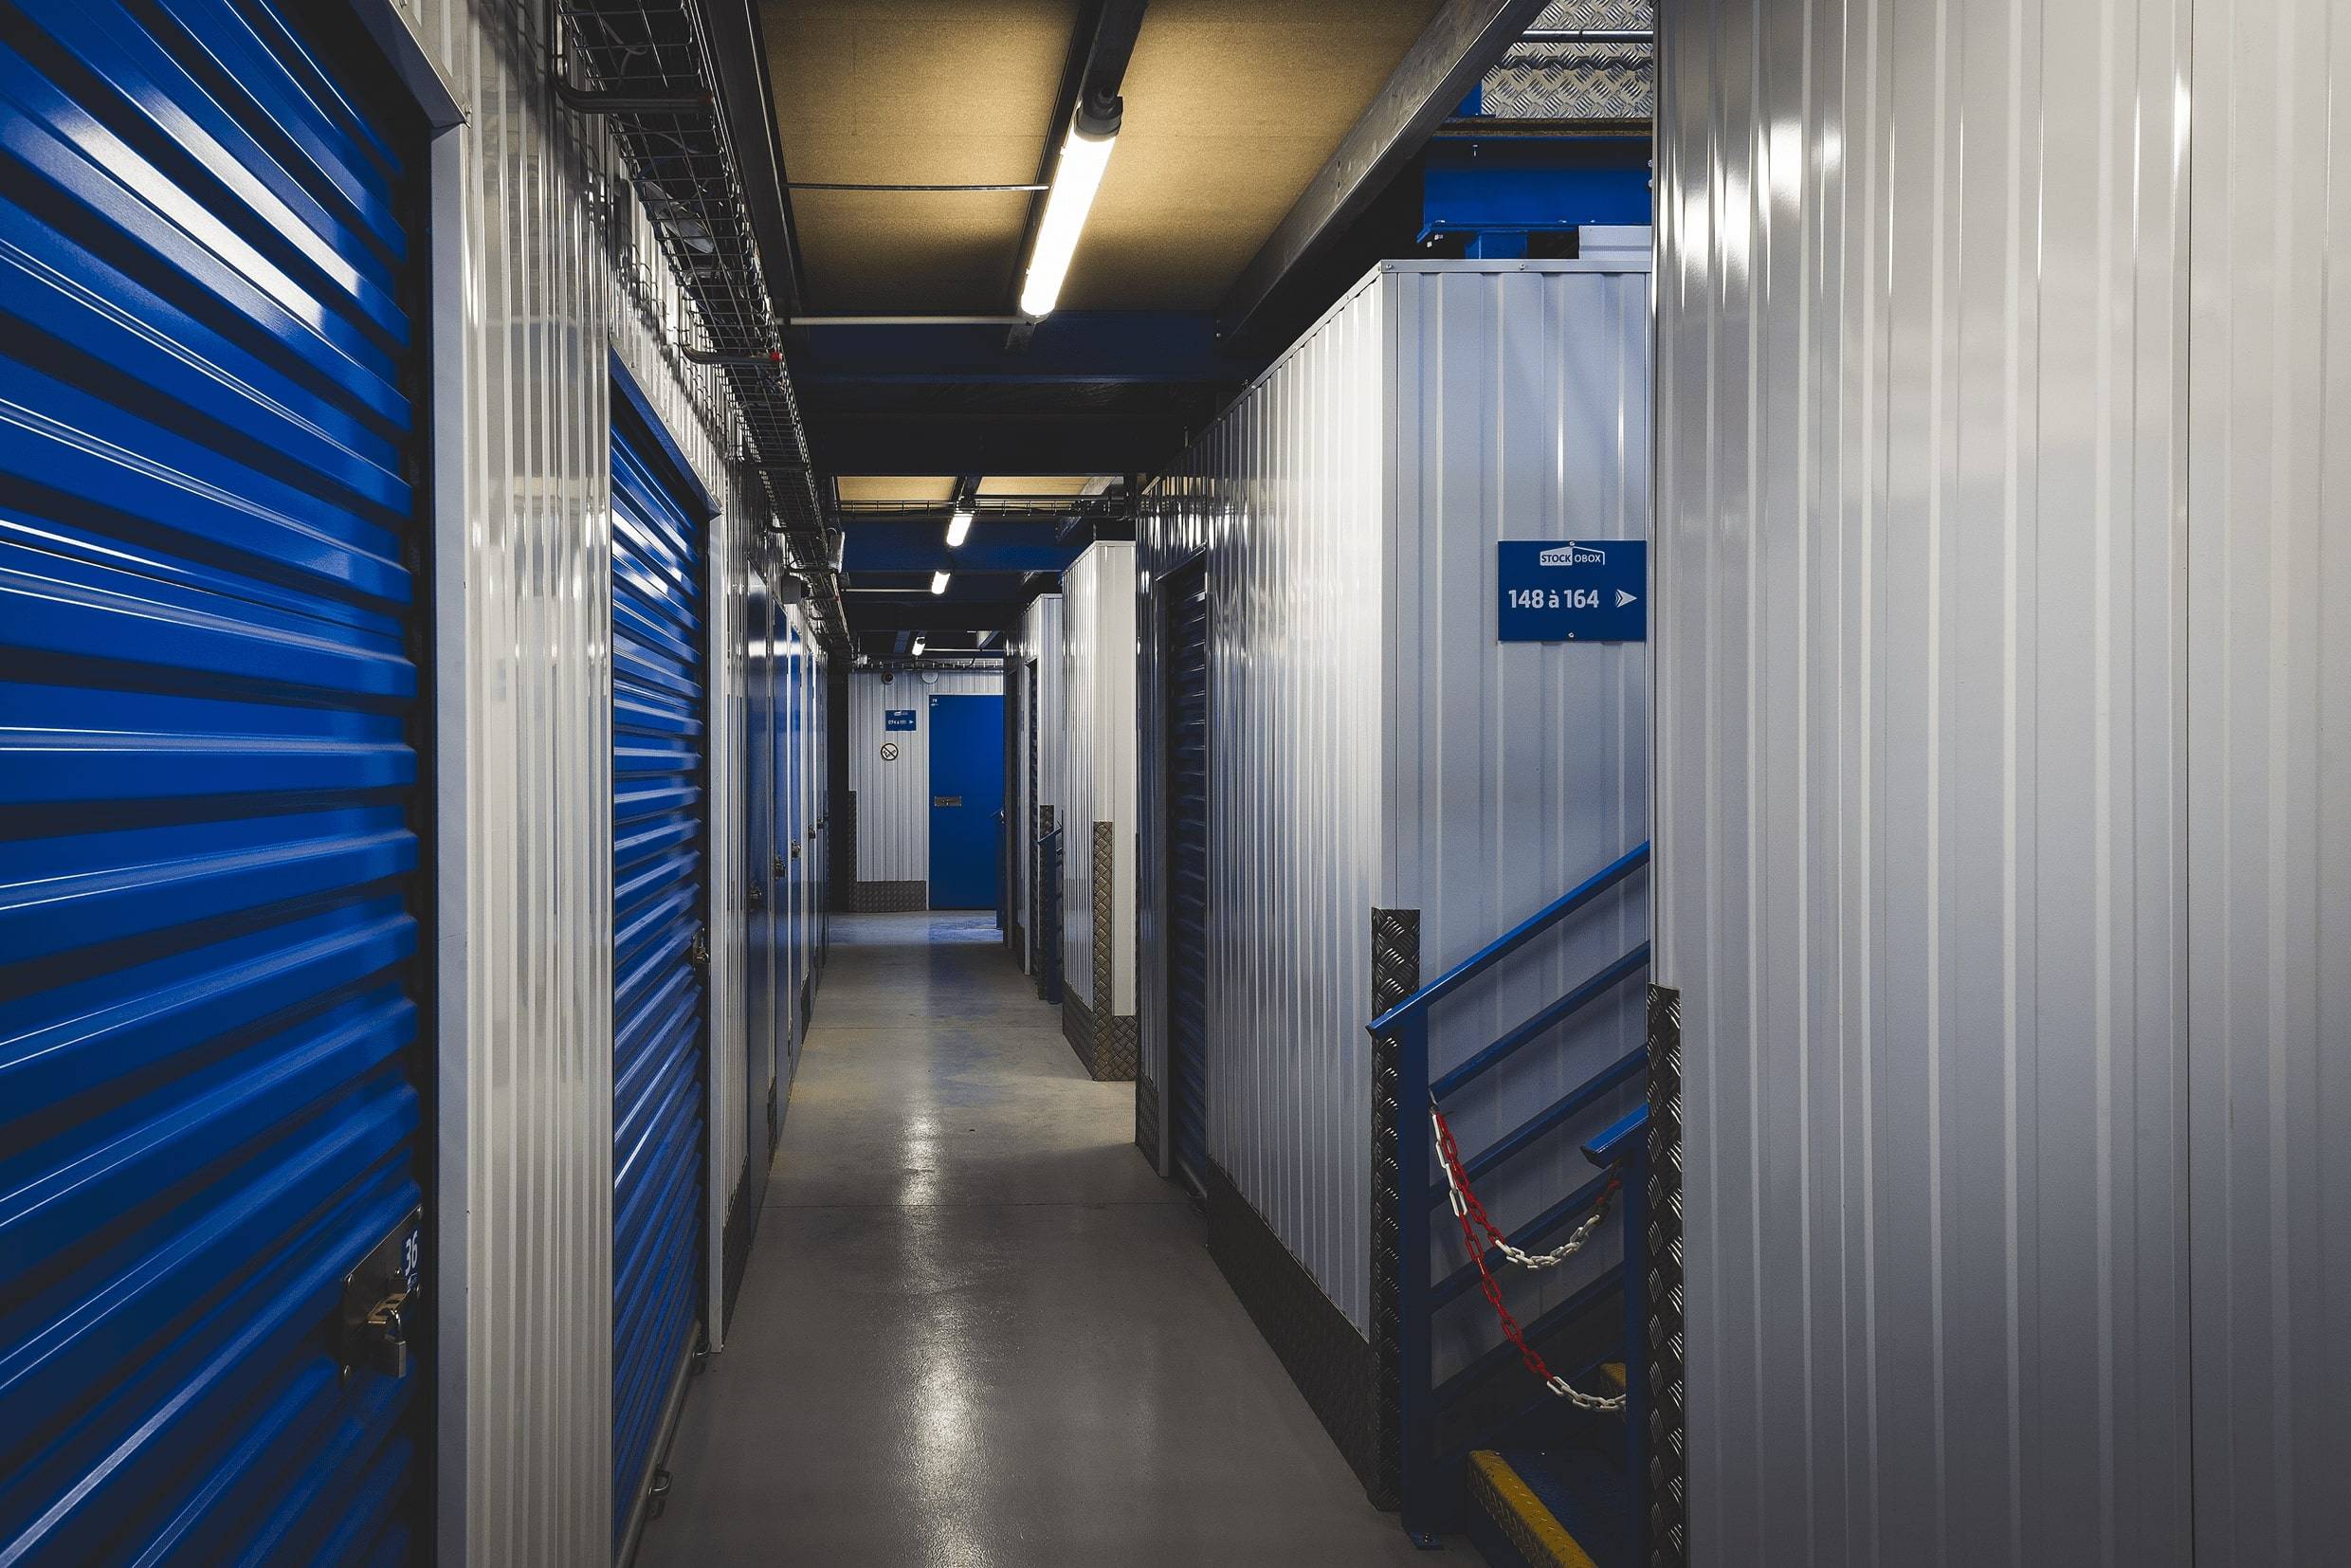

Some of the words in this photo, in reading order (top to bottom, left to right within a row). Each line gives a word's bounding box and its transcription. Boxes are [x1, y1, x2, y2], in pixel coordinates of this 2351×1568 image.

[1540, 554, 1572, 563] STOCK
[1574, 554, 1601, 563] OBOX
[1508, 590, 1544, 609] 148
[1548, 590, 1559, 609] à
[1563, 590, 1599, 609] 164
[405, 1230, 418, 1276] 36
